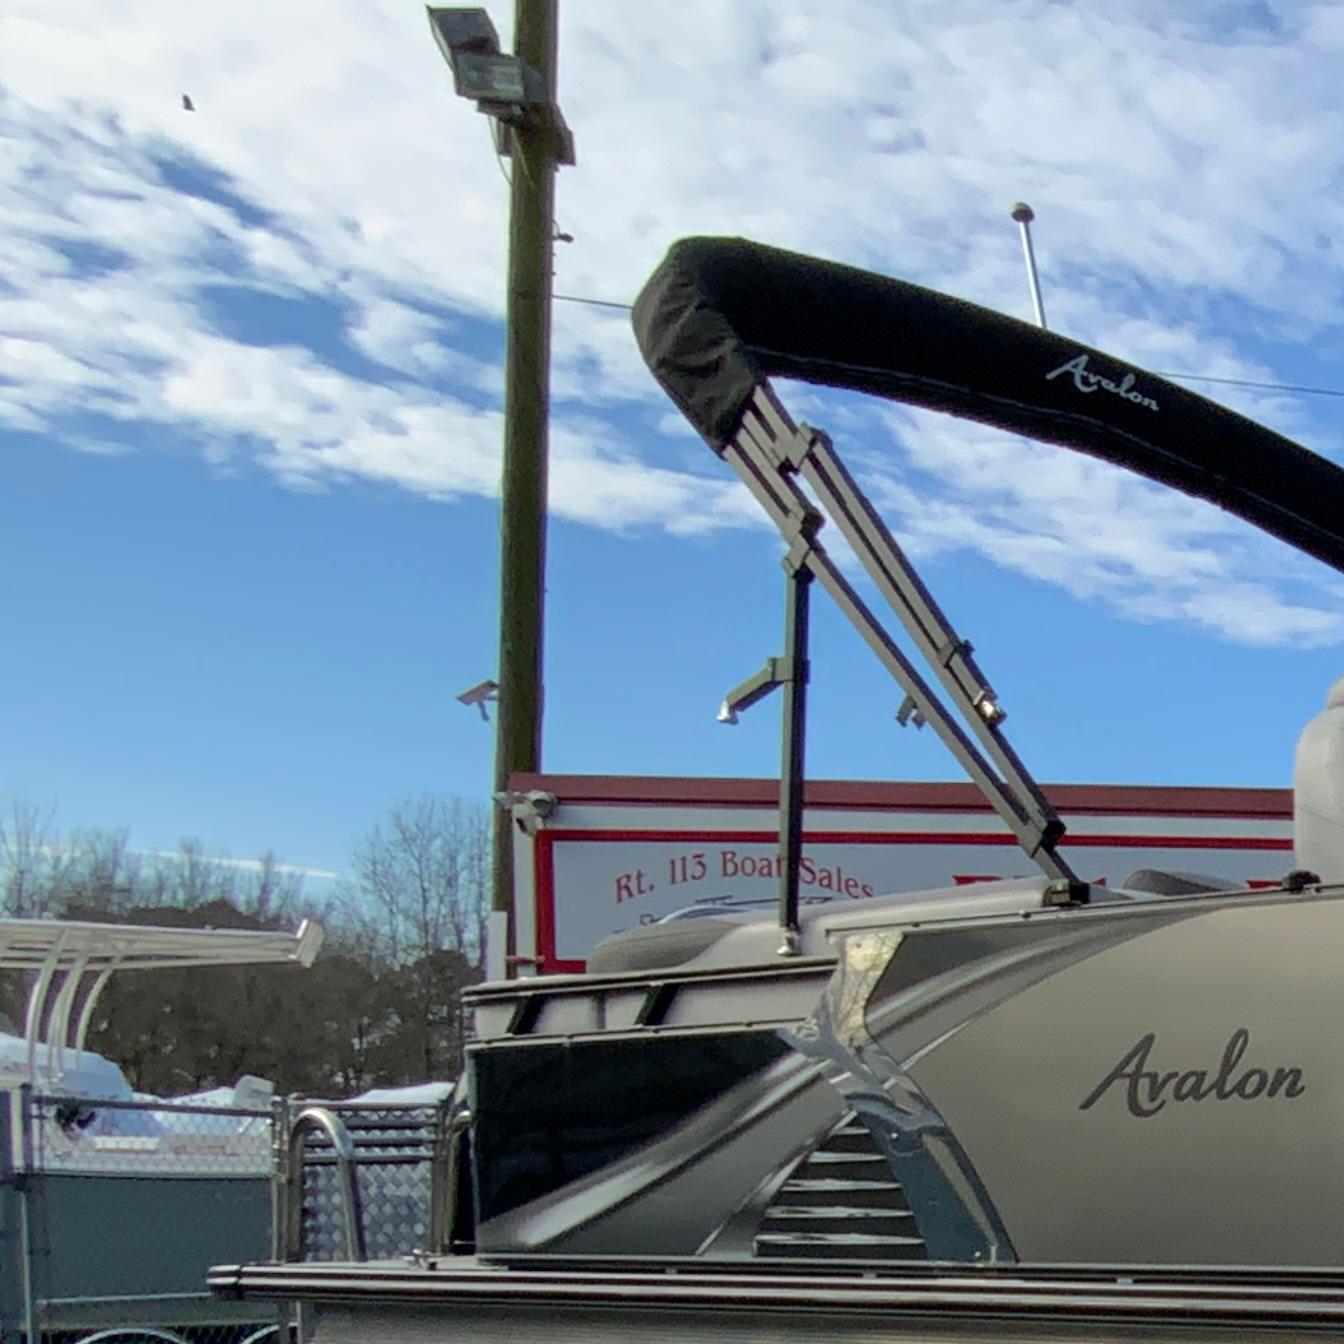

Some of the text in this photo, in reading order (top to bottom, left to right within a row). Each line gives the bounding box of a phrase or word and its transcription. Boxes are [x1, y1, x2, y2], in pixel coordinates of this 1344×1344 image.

[1046, 355, 1160, 411] Avalon
[614, 850, 874, 903] Rt. 113 Boat Sales
[1079, 1028, 1305, 1117] Avalon
